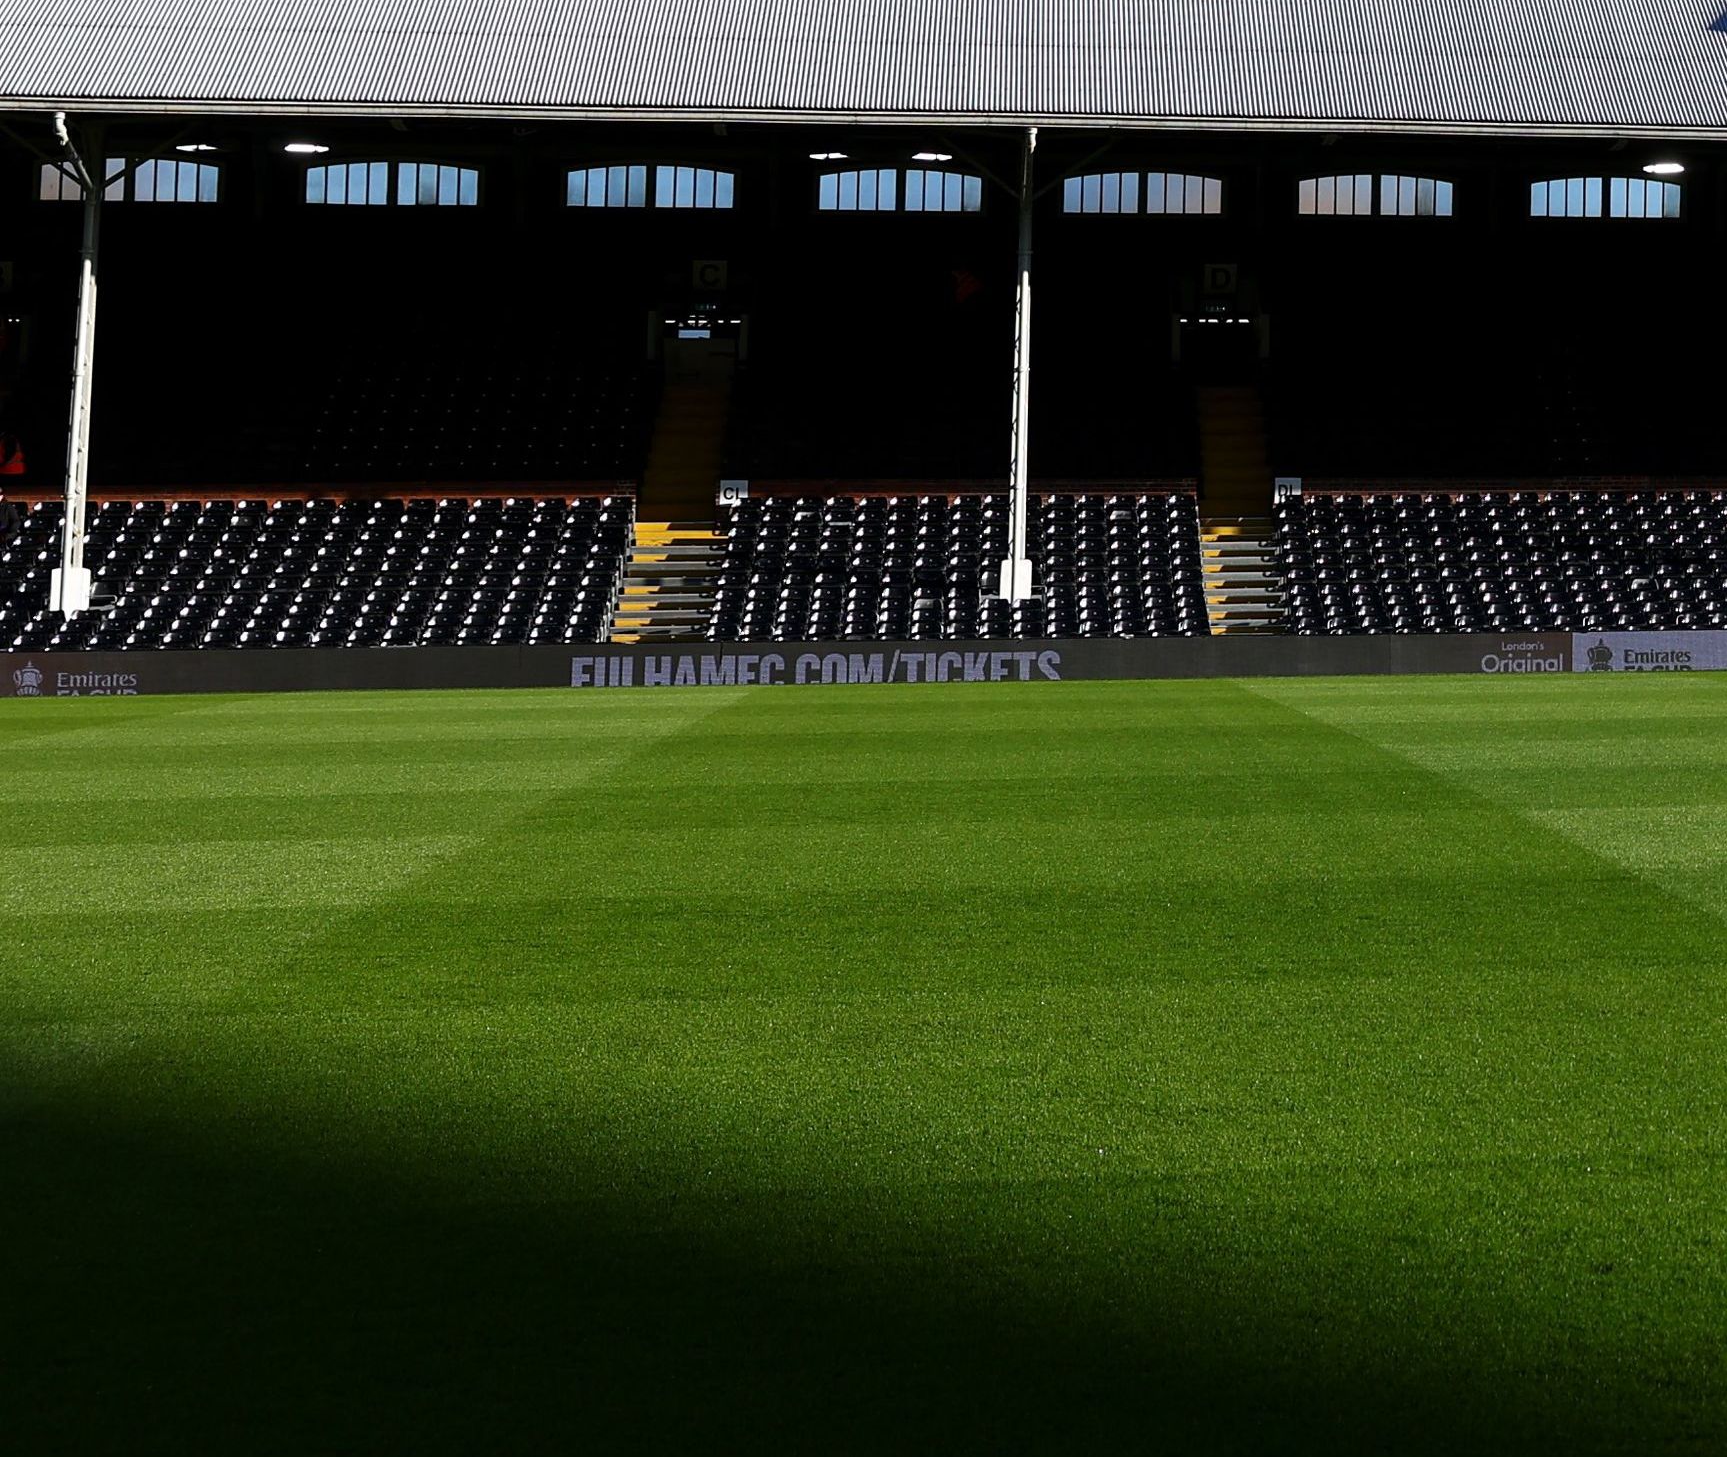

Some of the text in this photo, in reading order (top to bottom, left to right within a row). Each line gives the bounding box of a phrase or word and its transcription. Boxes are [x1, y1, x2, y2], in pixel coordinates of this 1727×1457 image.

[1502, 642, 1544, 651] London's
[1481, 653, 1563, 673] Original
[1624, 649, 1691, 664] Emirates
[571, 650, 1062, 687] FULHAMFCCOM/TICKETS
[57, 671, 138, 688] Emirates
